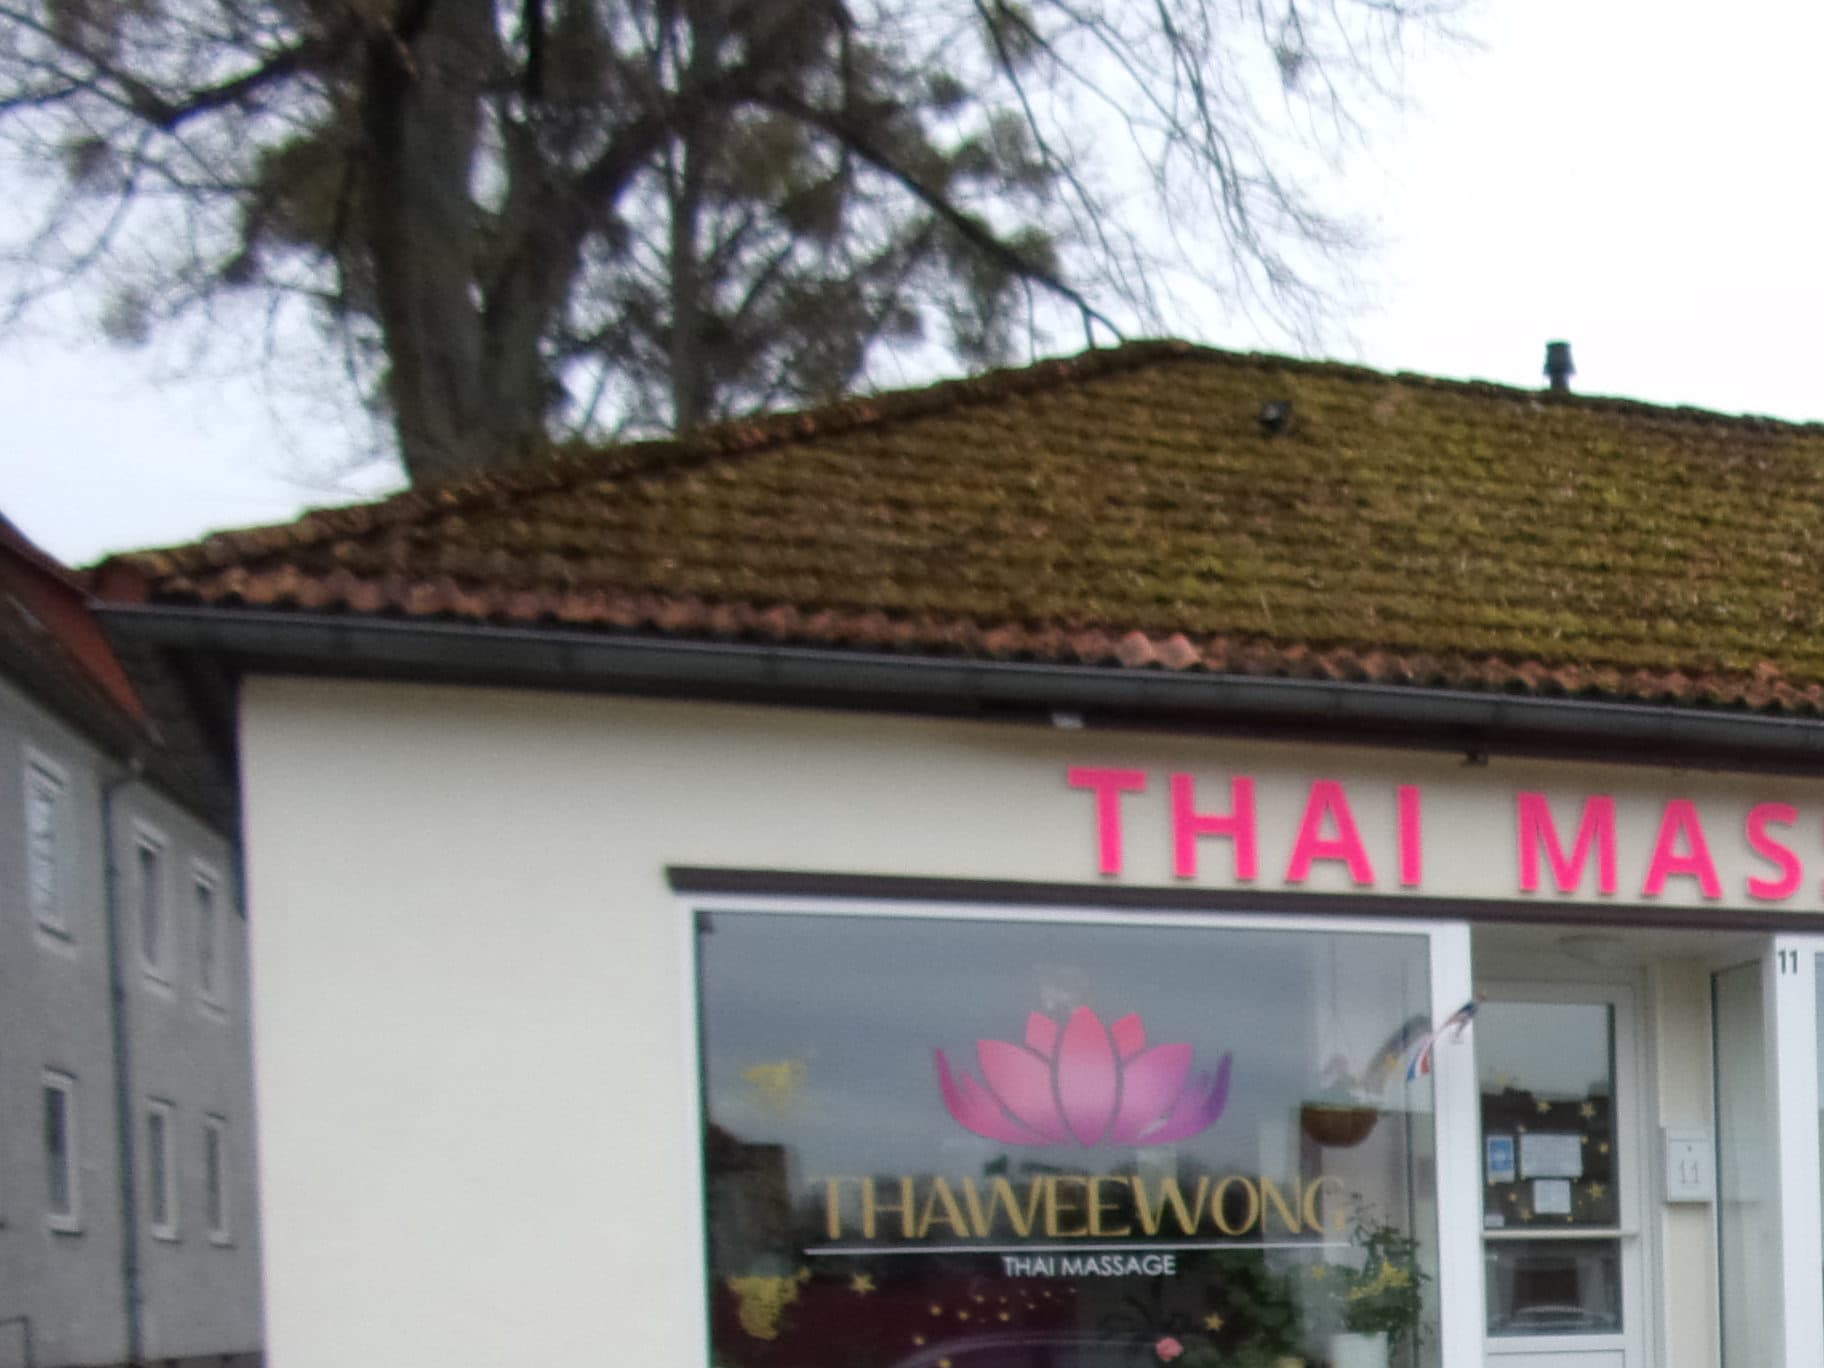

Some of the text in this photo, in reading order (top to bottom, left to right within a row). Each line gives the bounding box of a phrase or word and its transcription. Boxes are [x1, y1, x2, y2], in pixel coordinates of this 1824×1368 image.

[1065, 766, 1424, 889] THAI
[1778, 949, 1799, 975] 11
[1677, 1160, 1701, 1185] 11
[806, 1172, 1347, 1239] THAWEEWONG
[1003, 1253, 1178, 1279] THAI MASSAGE
